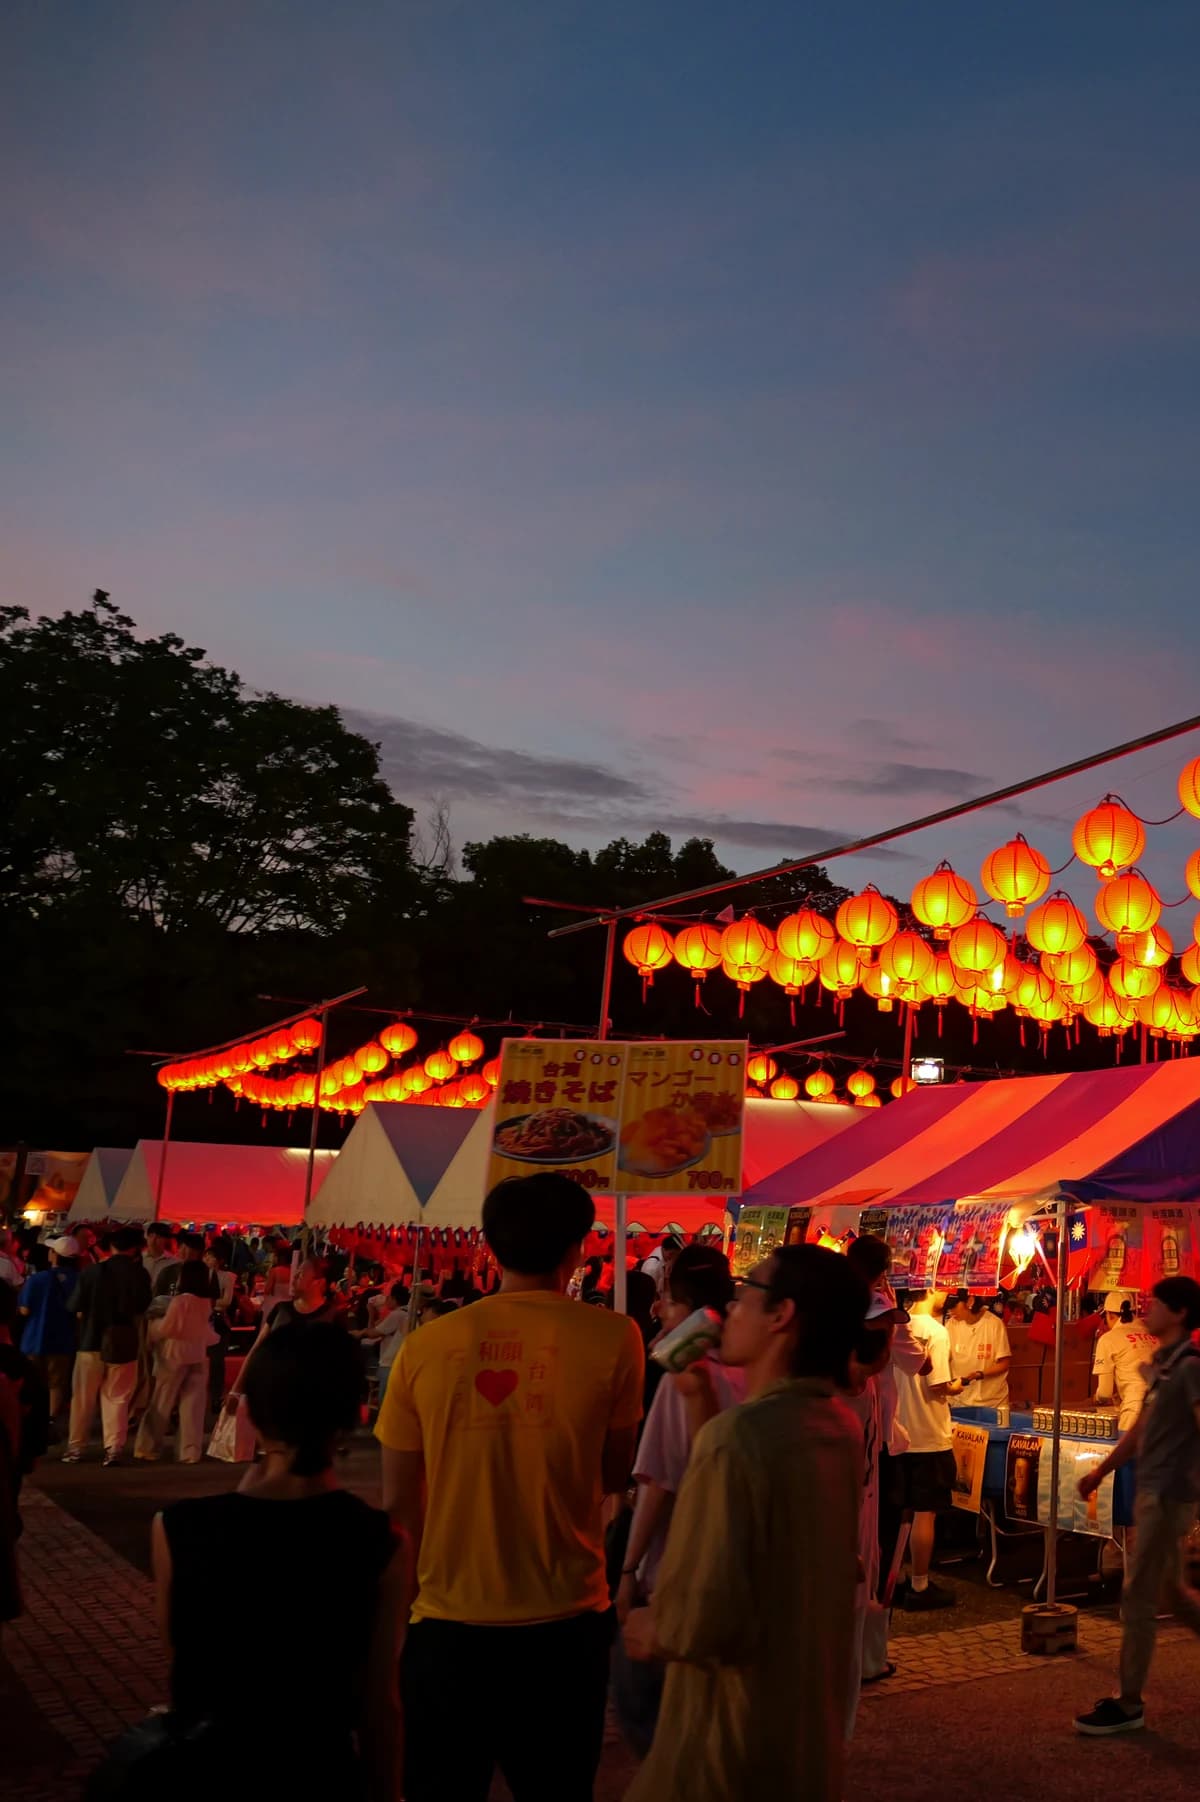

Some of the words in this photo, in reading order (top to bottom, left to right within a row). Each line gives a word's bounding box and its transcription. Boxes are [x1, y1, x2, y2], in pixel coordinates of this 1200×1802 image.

[627, 1070, 715, 1087] マンゴー
[502, 1079, 617, 1104] 焼きそば
[957, 1431, 985, 1444] KAVALAN
[1010, 1439, 1040, 1451] KAVALAN
